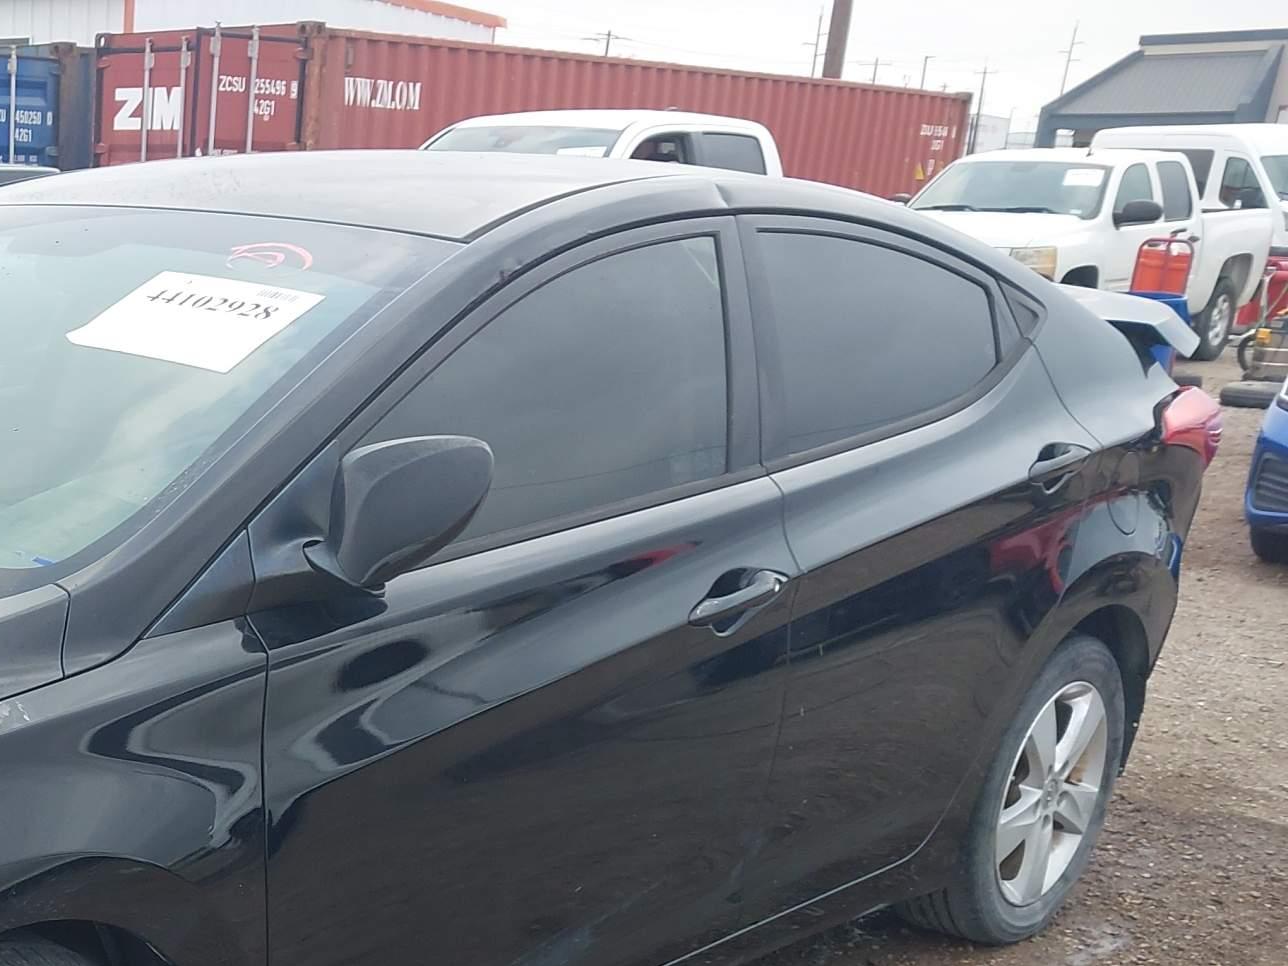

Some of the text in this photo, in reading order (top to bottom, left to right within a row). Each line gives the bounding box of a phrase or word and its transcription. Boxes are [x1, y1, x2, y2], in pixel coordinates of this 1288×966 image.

[218, 75, 246, 92] ZCSU
[254, 78, 285, 96] 255496
[113, 86, 183, 131] ZIM
[146, 289, 279, 320] 44102928
